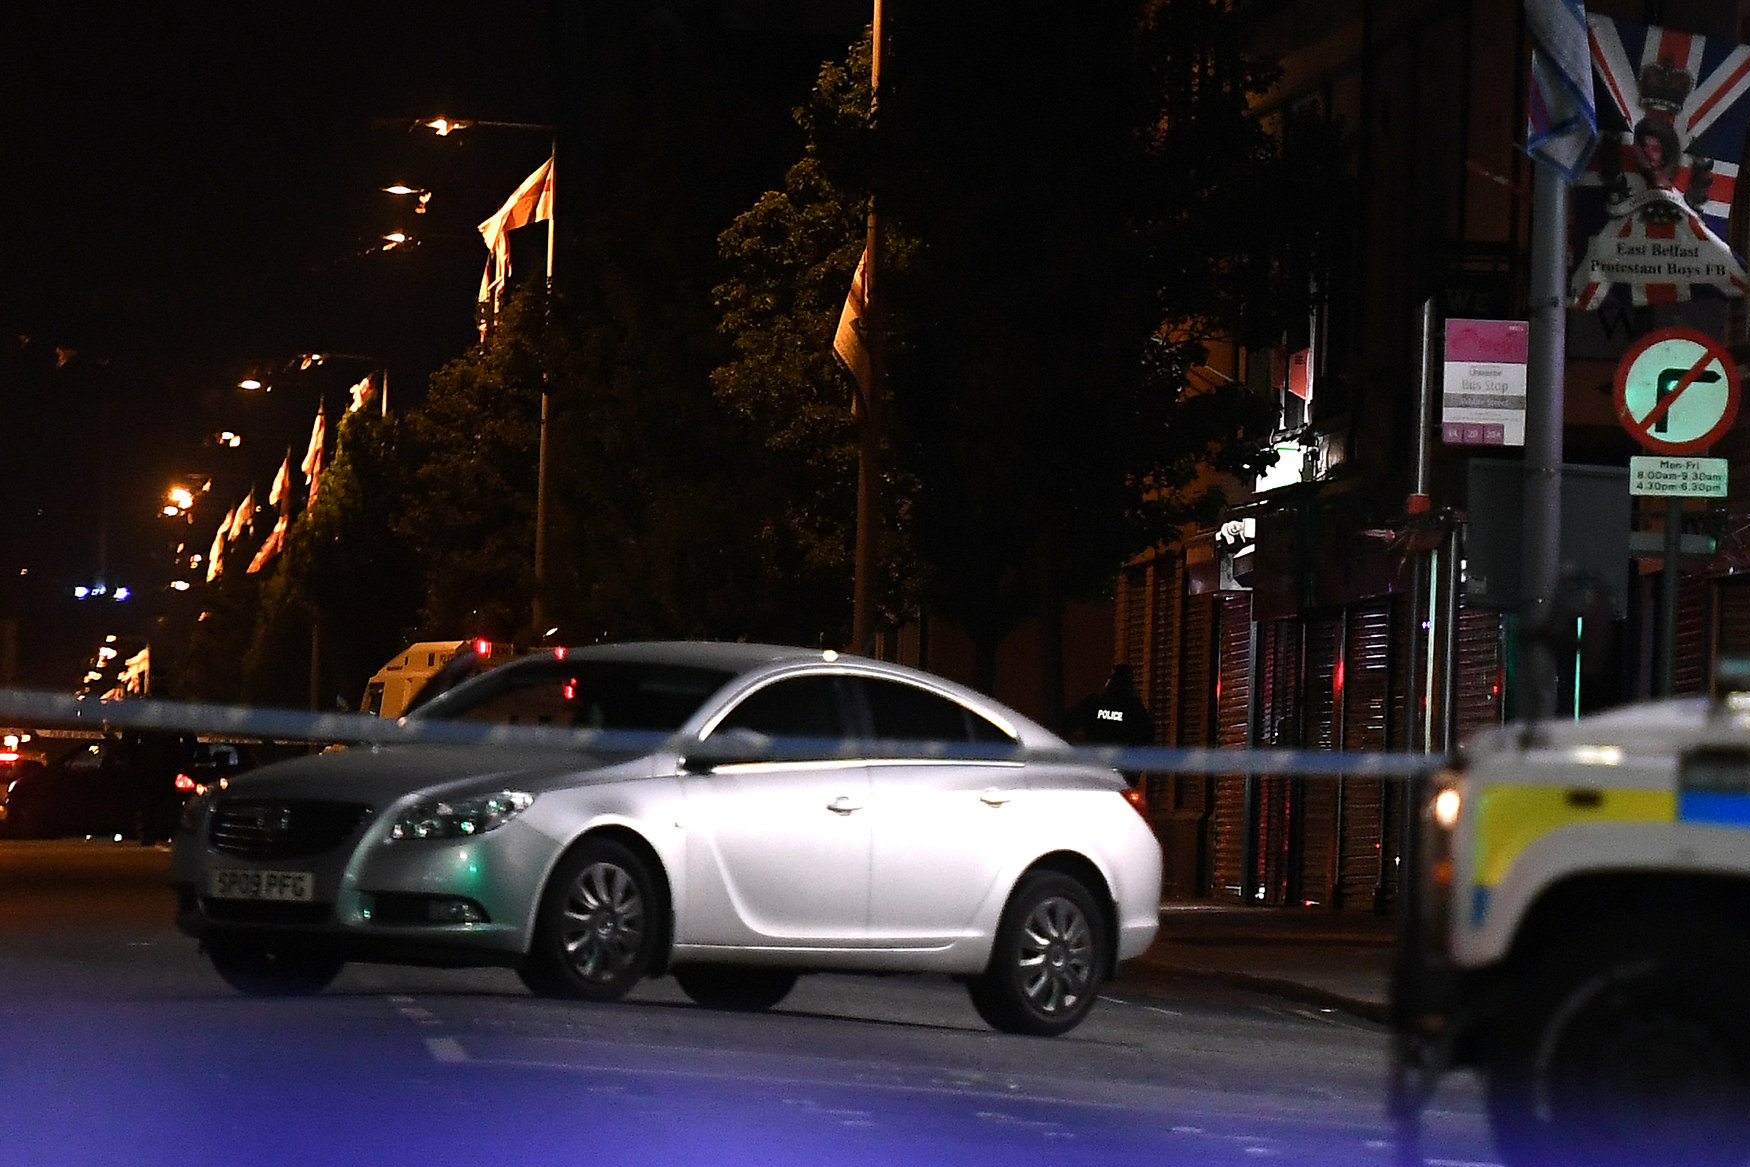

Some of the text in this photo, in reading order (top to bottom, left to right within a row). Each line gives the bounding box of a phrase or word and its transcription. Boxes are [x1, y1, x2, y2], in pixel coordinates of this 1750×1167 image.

[1617, 243, 1699, 258] East Belfast
[1591, 259, 1726, 277] Protestant Boys FB
[1461, 380, 1509, 393] Bus Stop
[1097, 709, 1123, 721] POLICE
